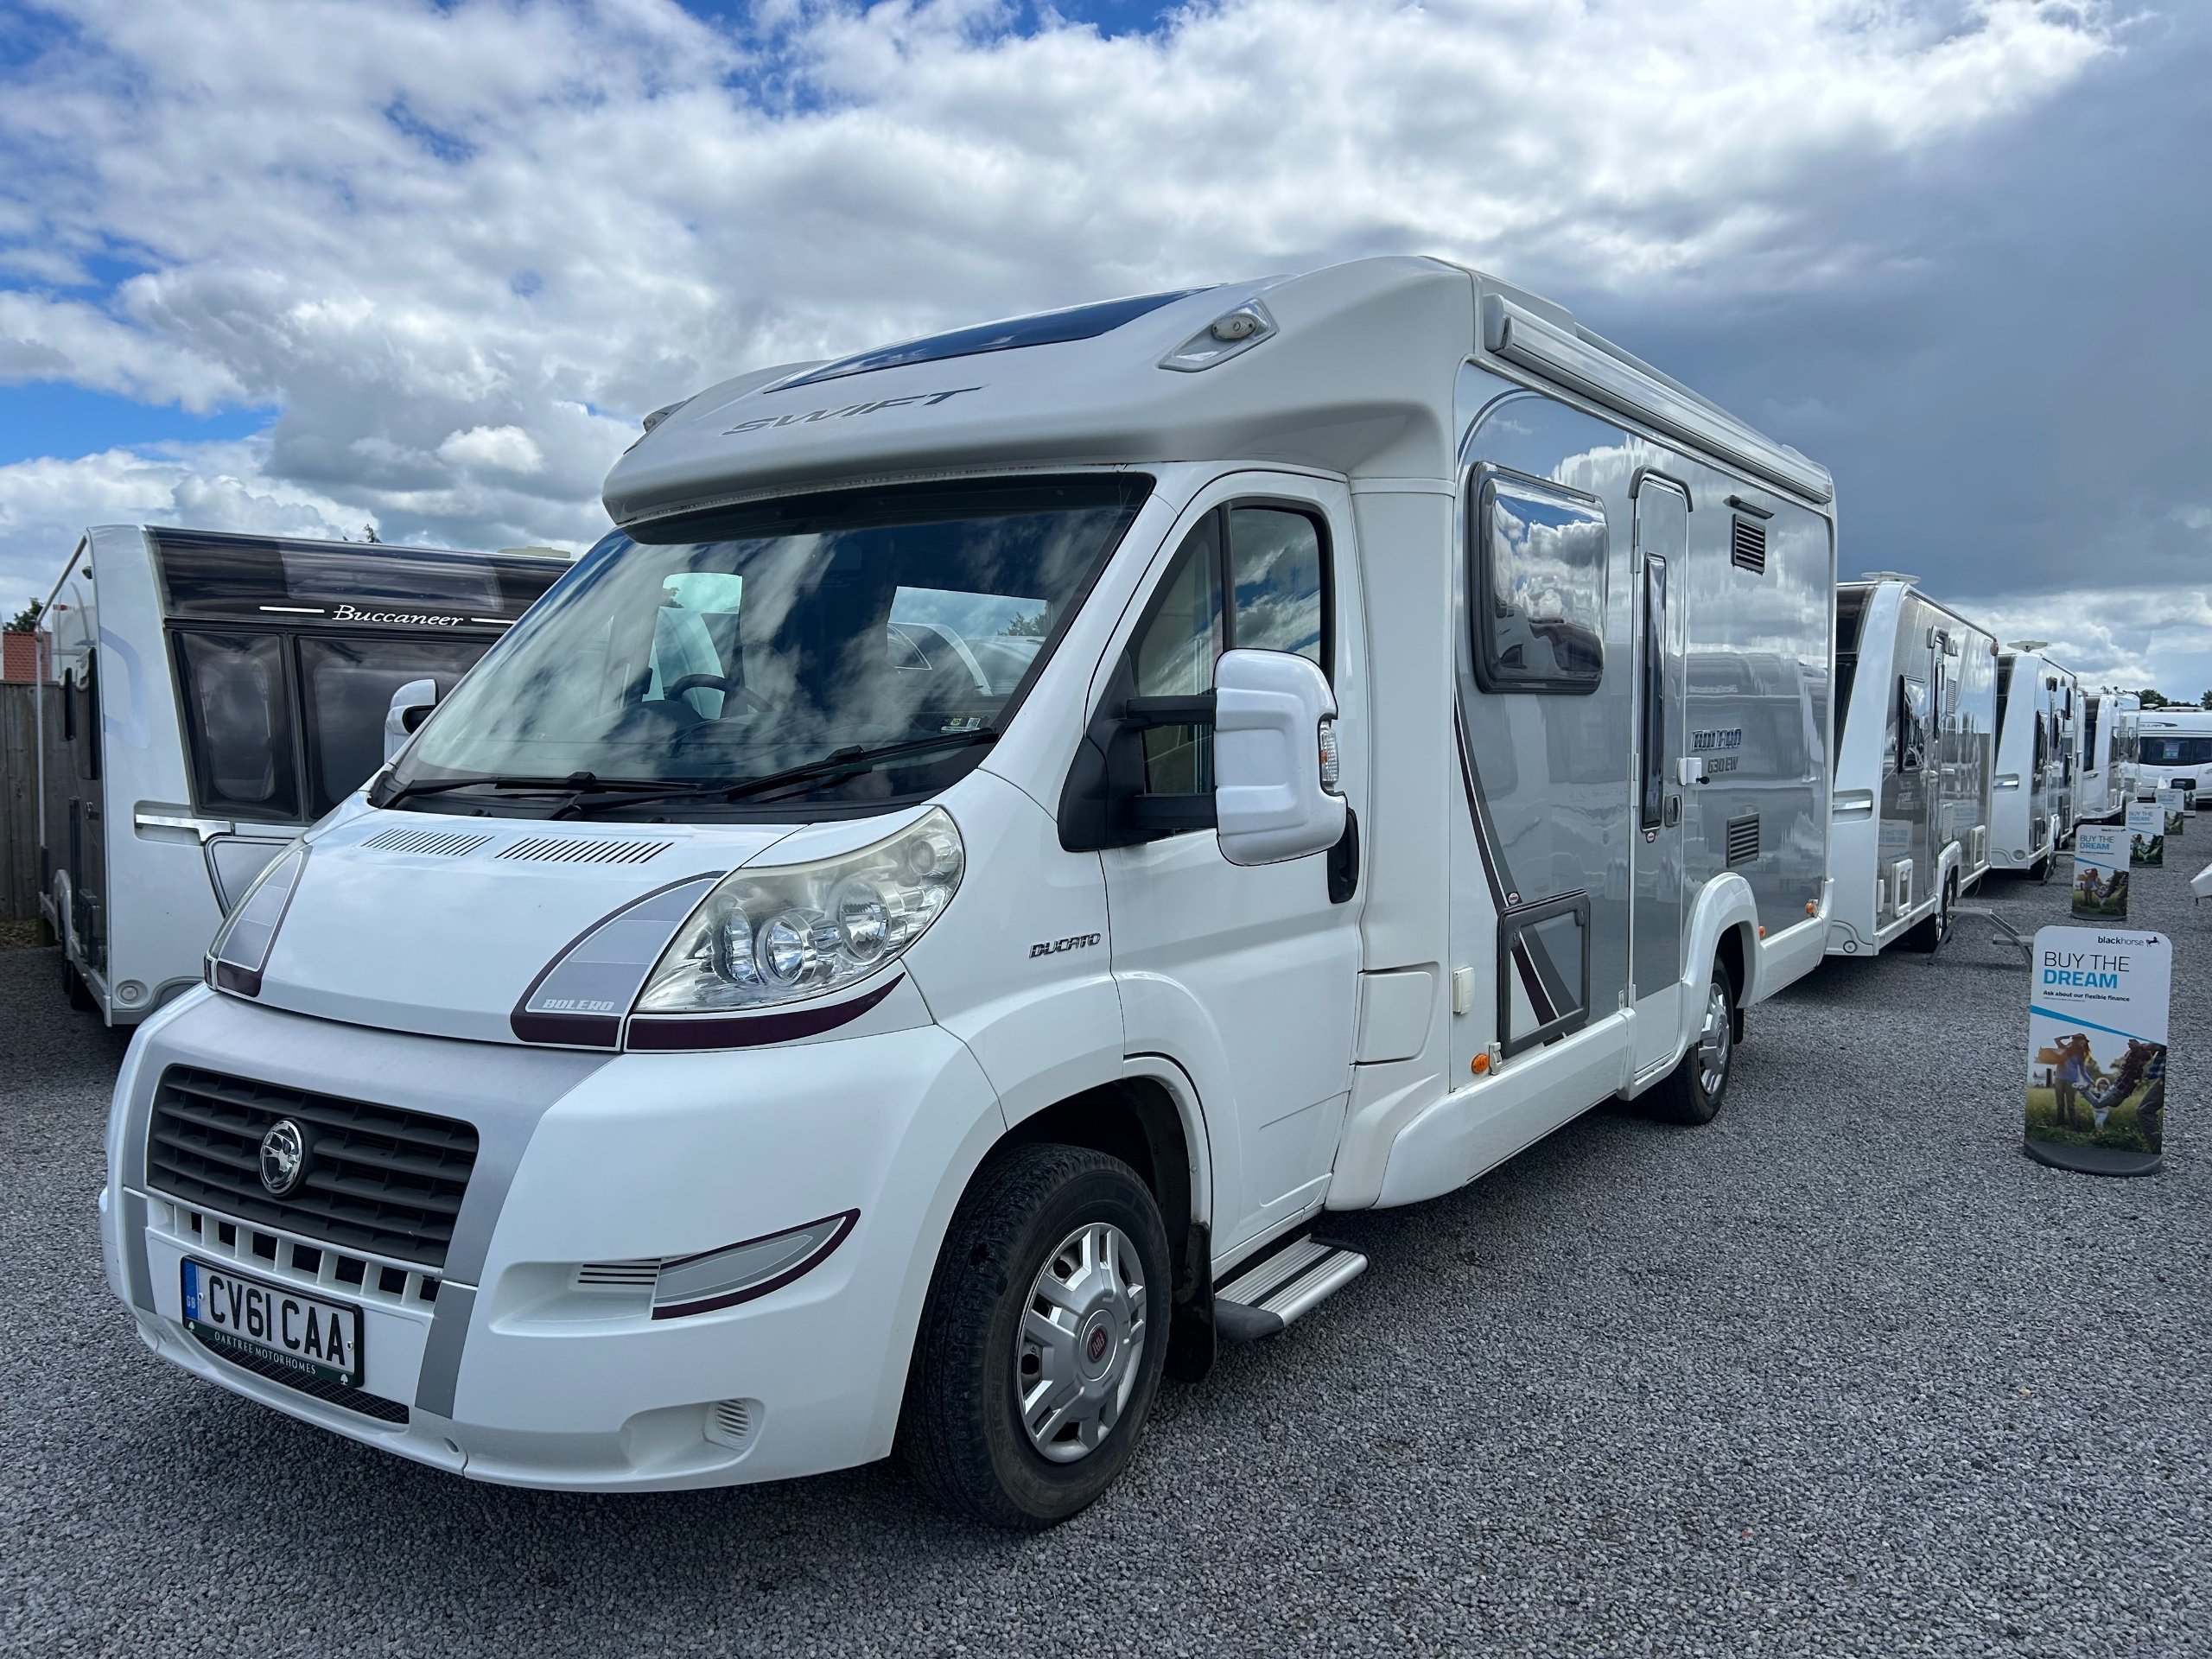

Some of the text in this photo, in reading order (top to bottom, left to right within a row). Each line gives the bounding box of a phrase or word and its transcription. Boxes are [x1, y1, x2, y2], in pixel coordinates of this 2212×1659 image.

[721, 386, 984, 435] SWIFT
[332, 604, 464, 626] Buccaneer
[1707, 757, 1725, 773] 630
[1028, 932, 1102, 958] DUCATO
[2097, 936, 2145, 946] blackhorse
[2044, 951, 2131, 972] BUY THE
[2044, 969, 2118, 988] DREAM
[542, 999, 615, 1011] BOLERO
[186, 1294, 196, 1309] GB
[208, 1274, 346, 1366] CV61 CAA
[214, 1331, 316, 1375] OAKTREE MOTORHOMES
